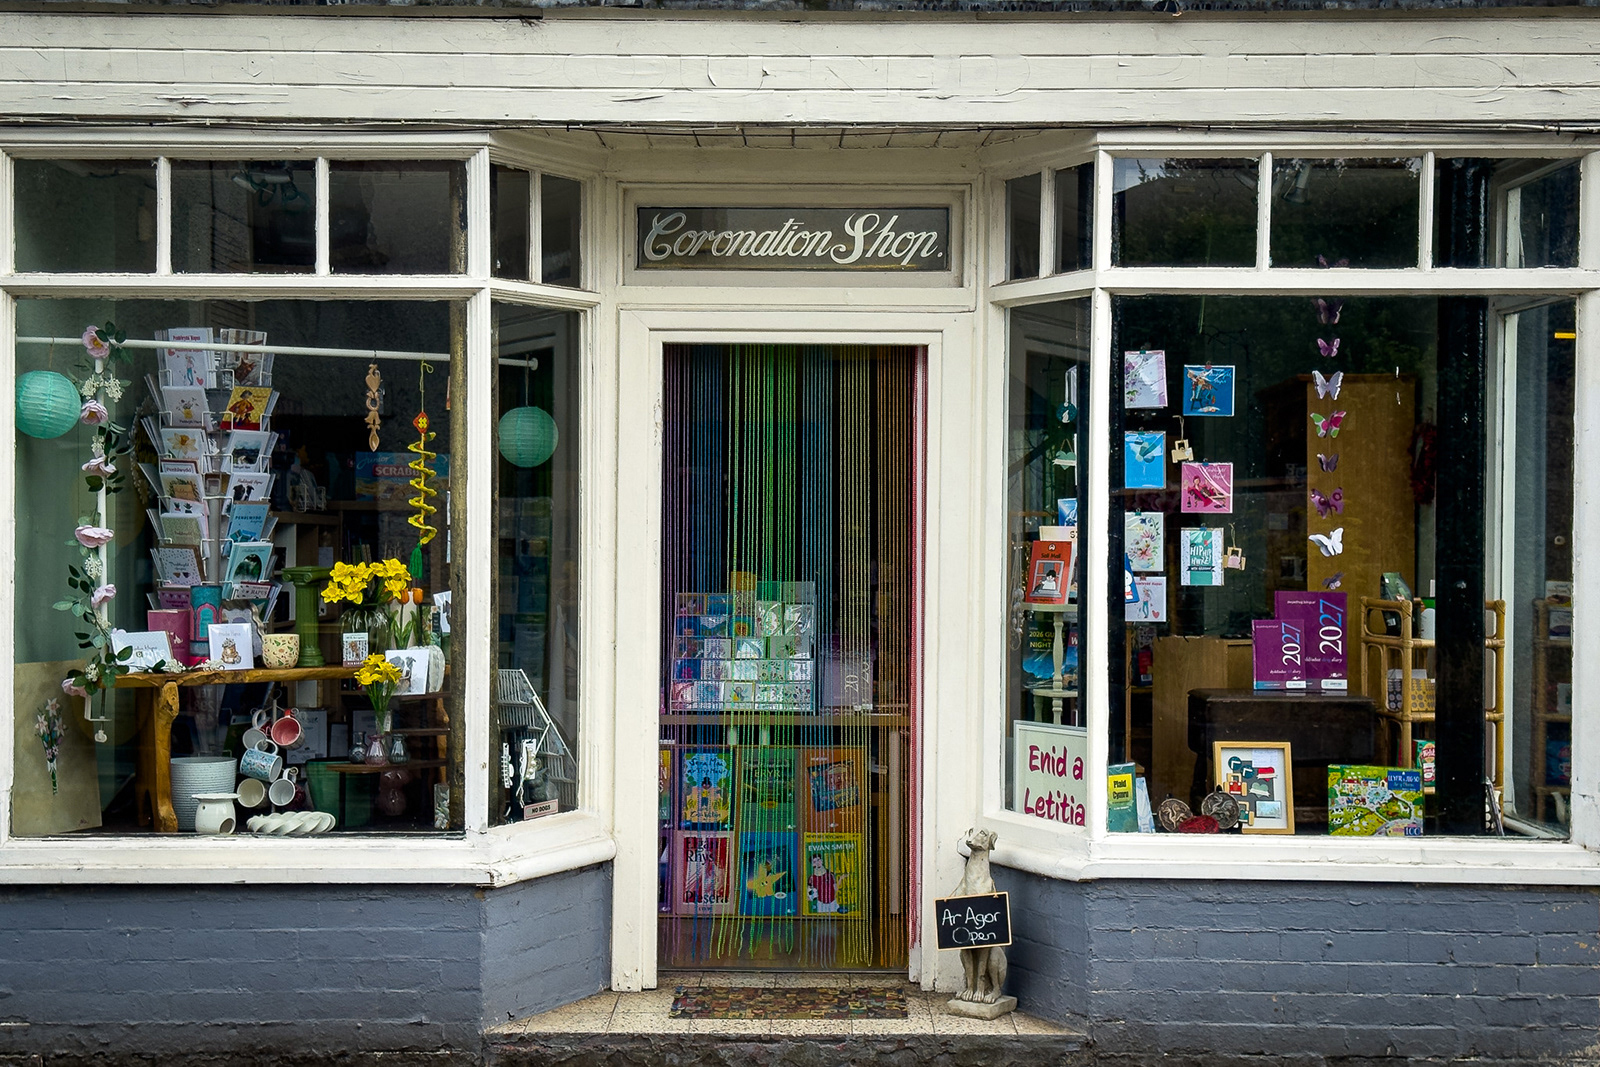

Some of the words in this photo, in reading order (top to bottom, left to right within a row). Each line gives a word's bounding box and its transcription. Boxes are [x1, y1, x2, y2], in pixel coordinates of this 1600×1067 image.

[644, 212, 831, 261] Coronation
[374, 466, 420, 476] SCRABB
[1190, 545, 1204, 556] HIP
[1319, 599, 1344, 655] 2027
[1282, 622, 1301, 666] 2027
[1028, 745, 1067, 777] Enid
[1073, 756, 1084, 780] a
[1113, 779, 1127, 788] Plaid
[1112, 791, 1129, 800] Cymru
[539, 804, 551, 813] DOGS
[1024, 787, 1086, 827] Letitia
[685, 848, 714, 866] Rhys
[808, 844, 831, 852] EWAN
[942, 908, 962, 926] Ar
[965, 906, 1001, 930] Agor
[952, 926, 997, 945] Open
